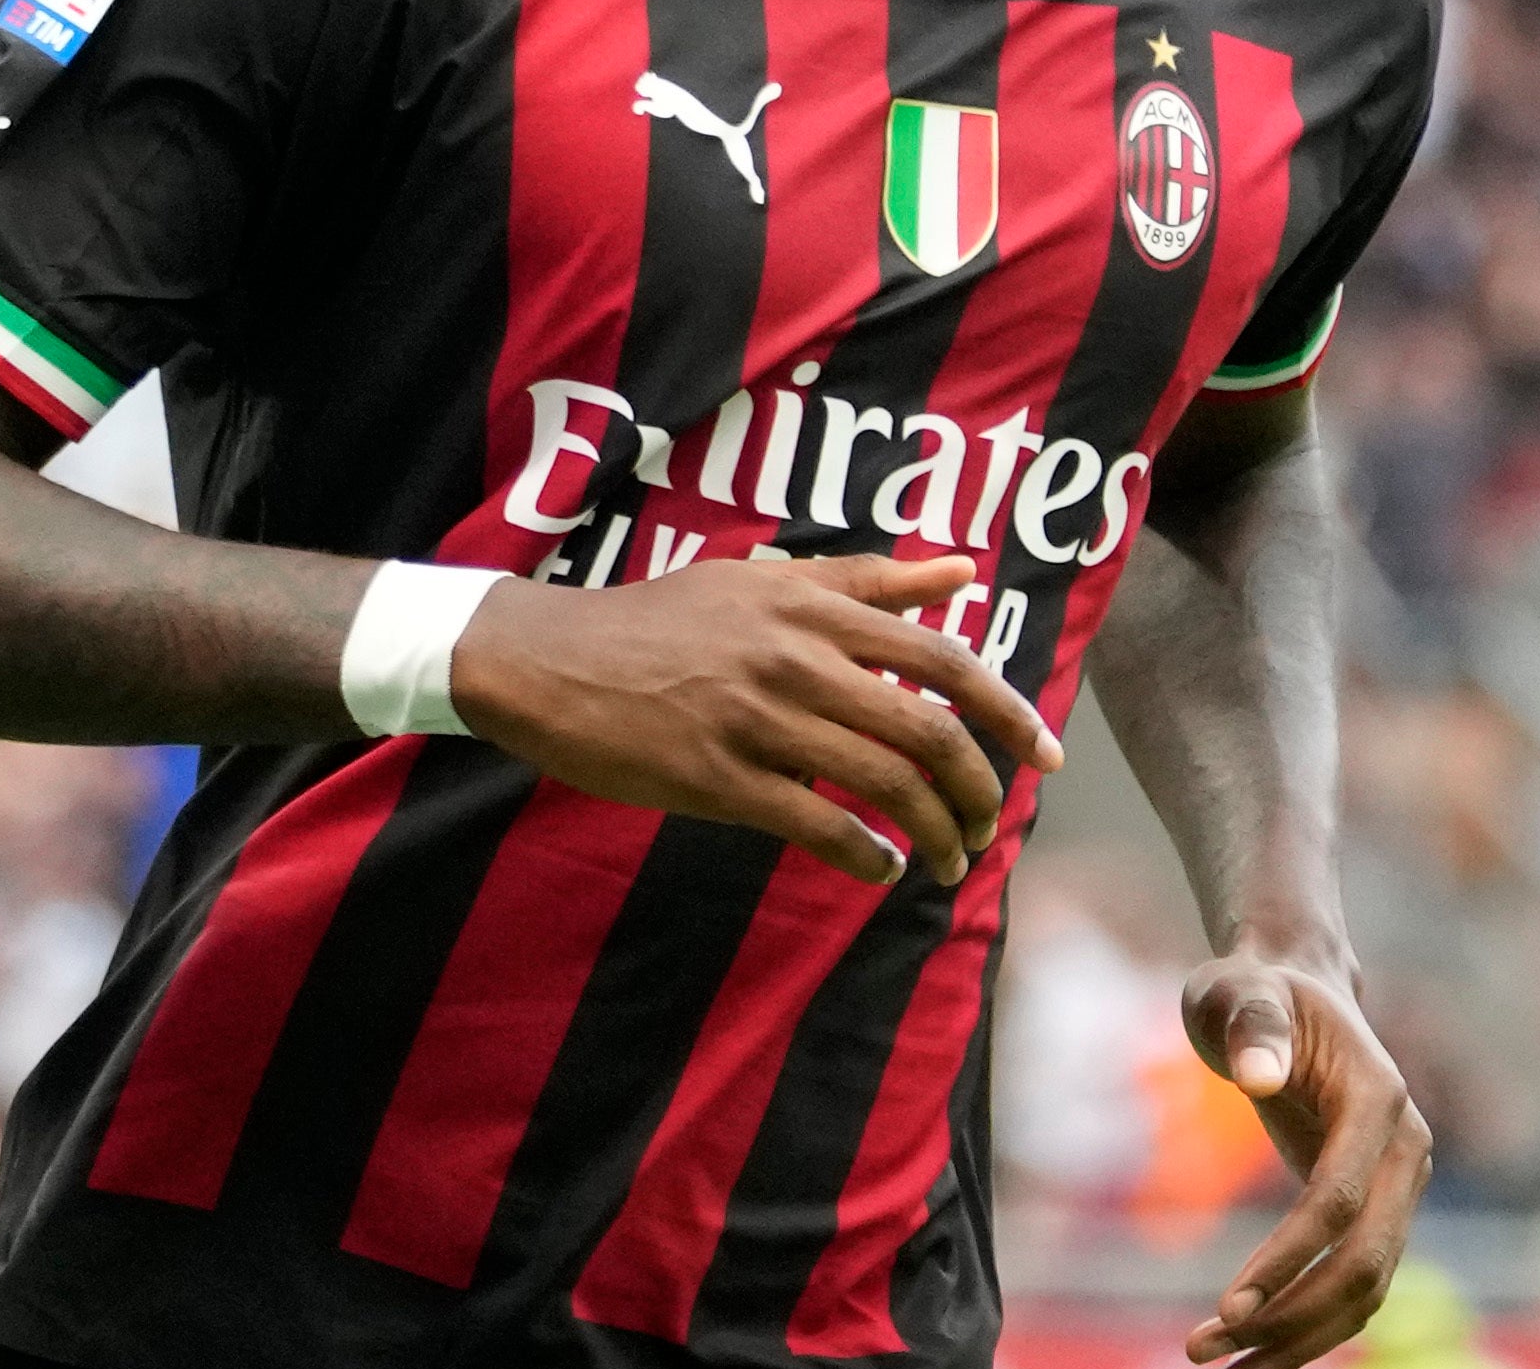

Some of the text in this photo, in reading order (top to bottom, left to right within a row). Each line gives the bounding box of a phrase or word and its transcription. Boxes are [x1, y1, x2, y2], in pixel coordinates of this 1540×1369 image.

[25, 9, 74, 52] TIM
[1141, 97, 1194, 131] ACM
[1143, 223, 1187, 248] 1899
[503, 361, 1150, 566] Emirates
